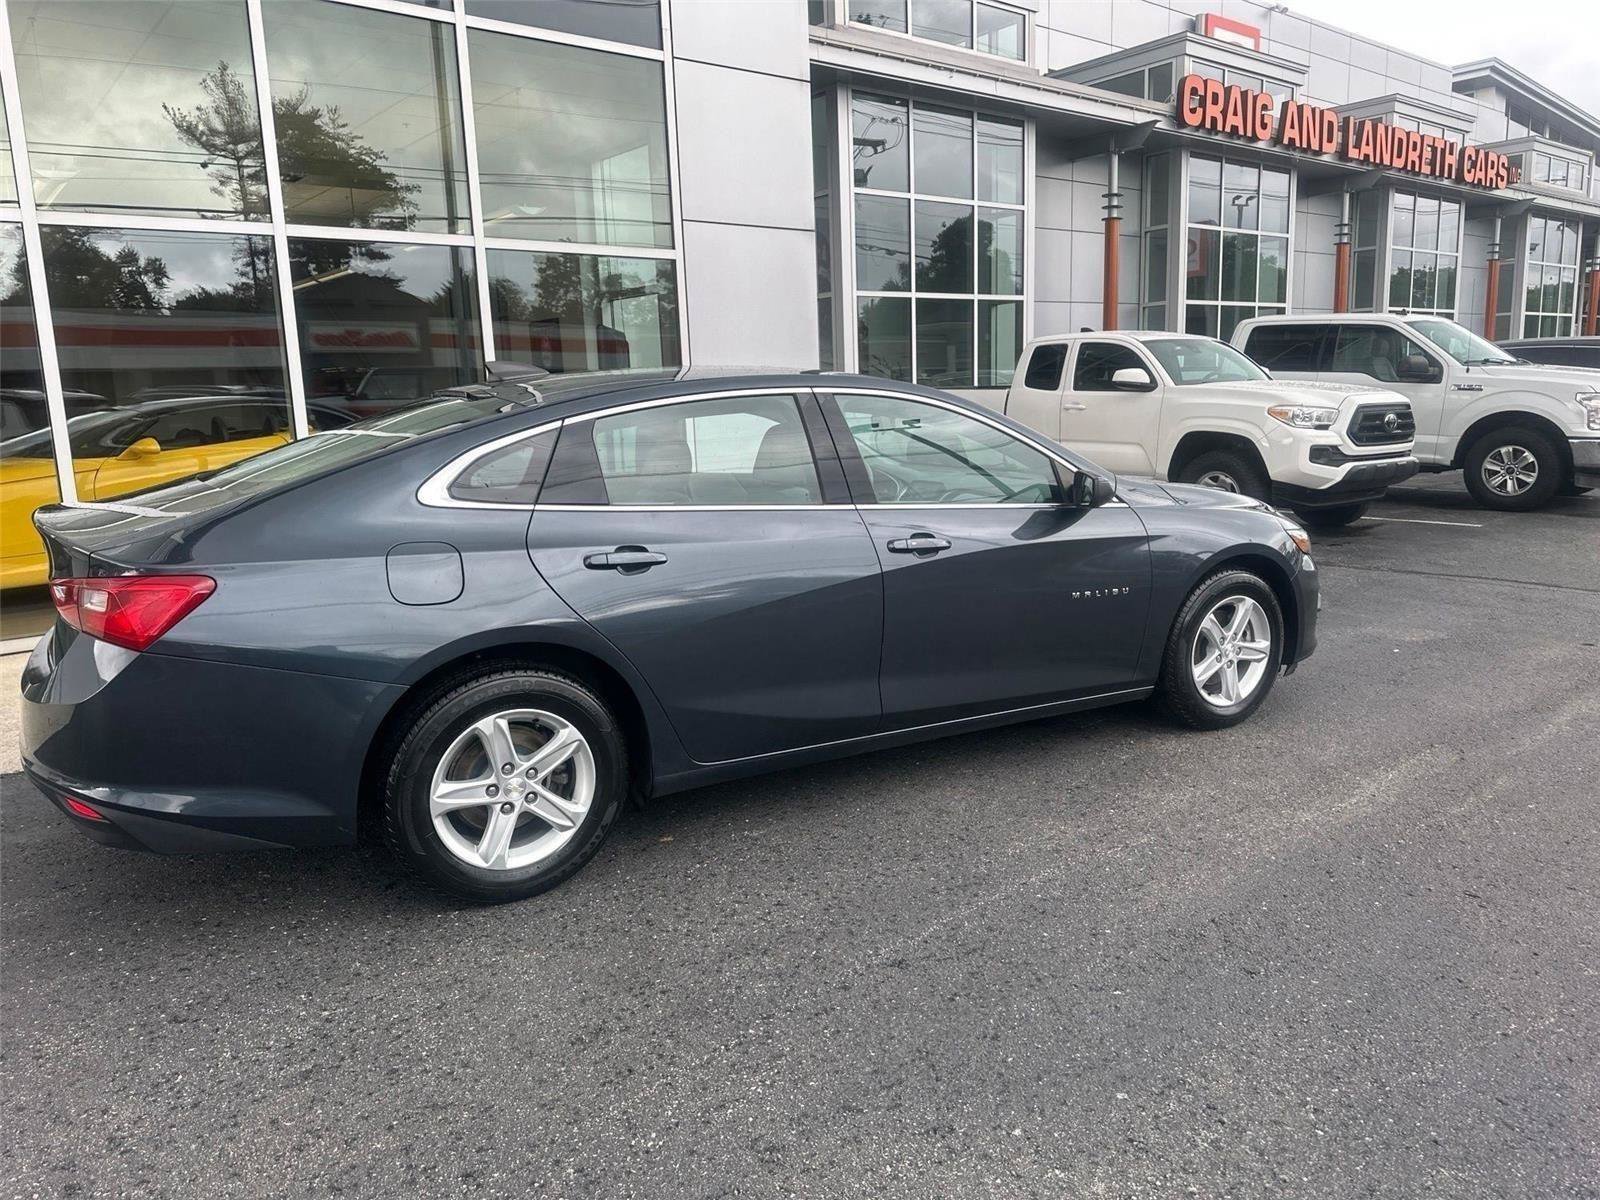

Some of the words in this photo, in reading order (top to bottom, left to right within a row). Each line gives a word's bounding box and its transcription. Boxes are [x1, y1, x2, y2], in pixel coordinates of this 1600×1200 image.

[1180, 74, 1275, 141] CRAIG
[1281, 101, 1339, 154] AND
[1347, 116, 1457, 180] LANDRETH
[1463, 145, 1509, 189] CARS
[1071, 587, 1129, 599] MALIBU
